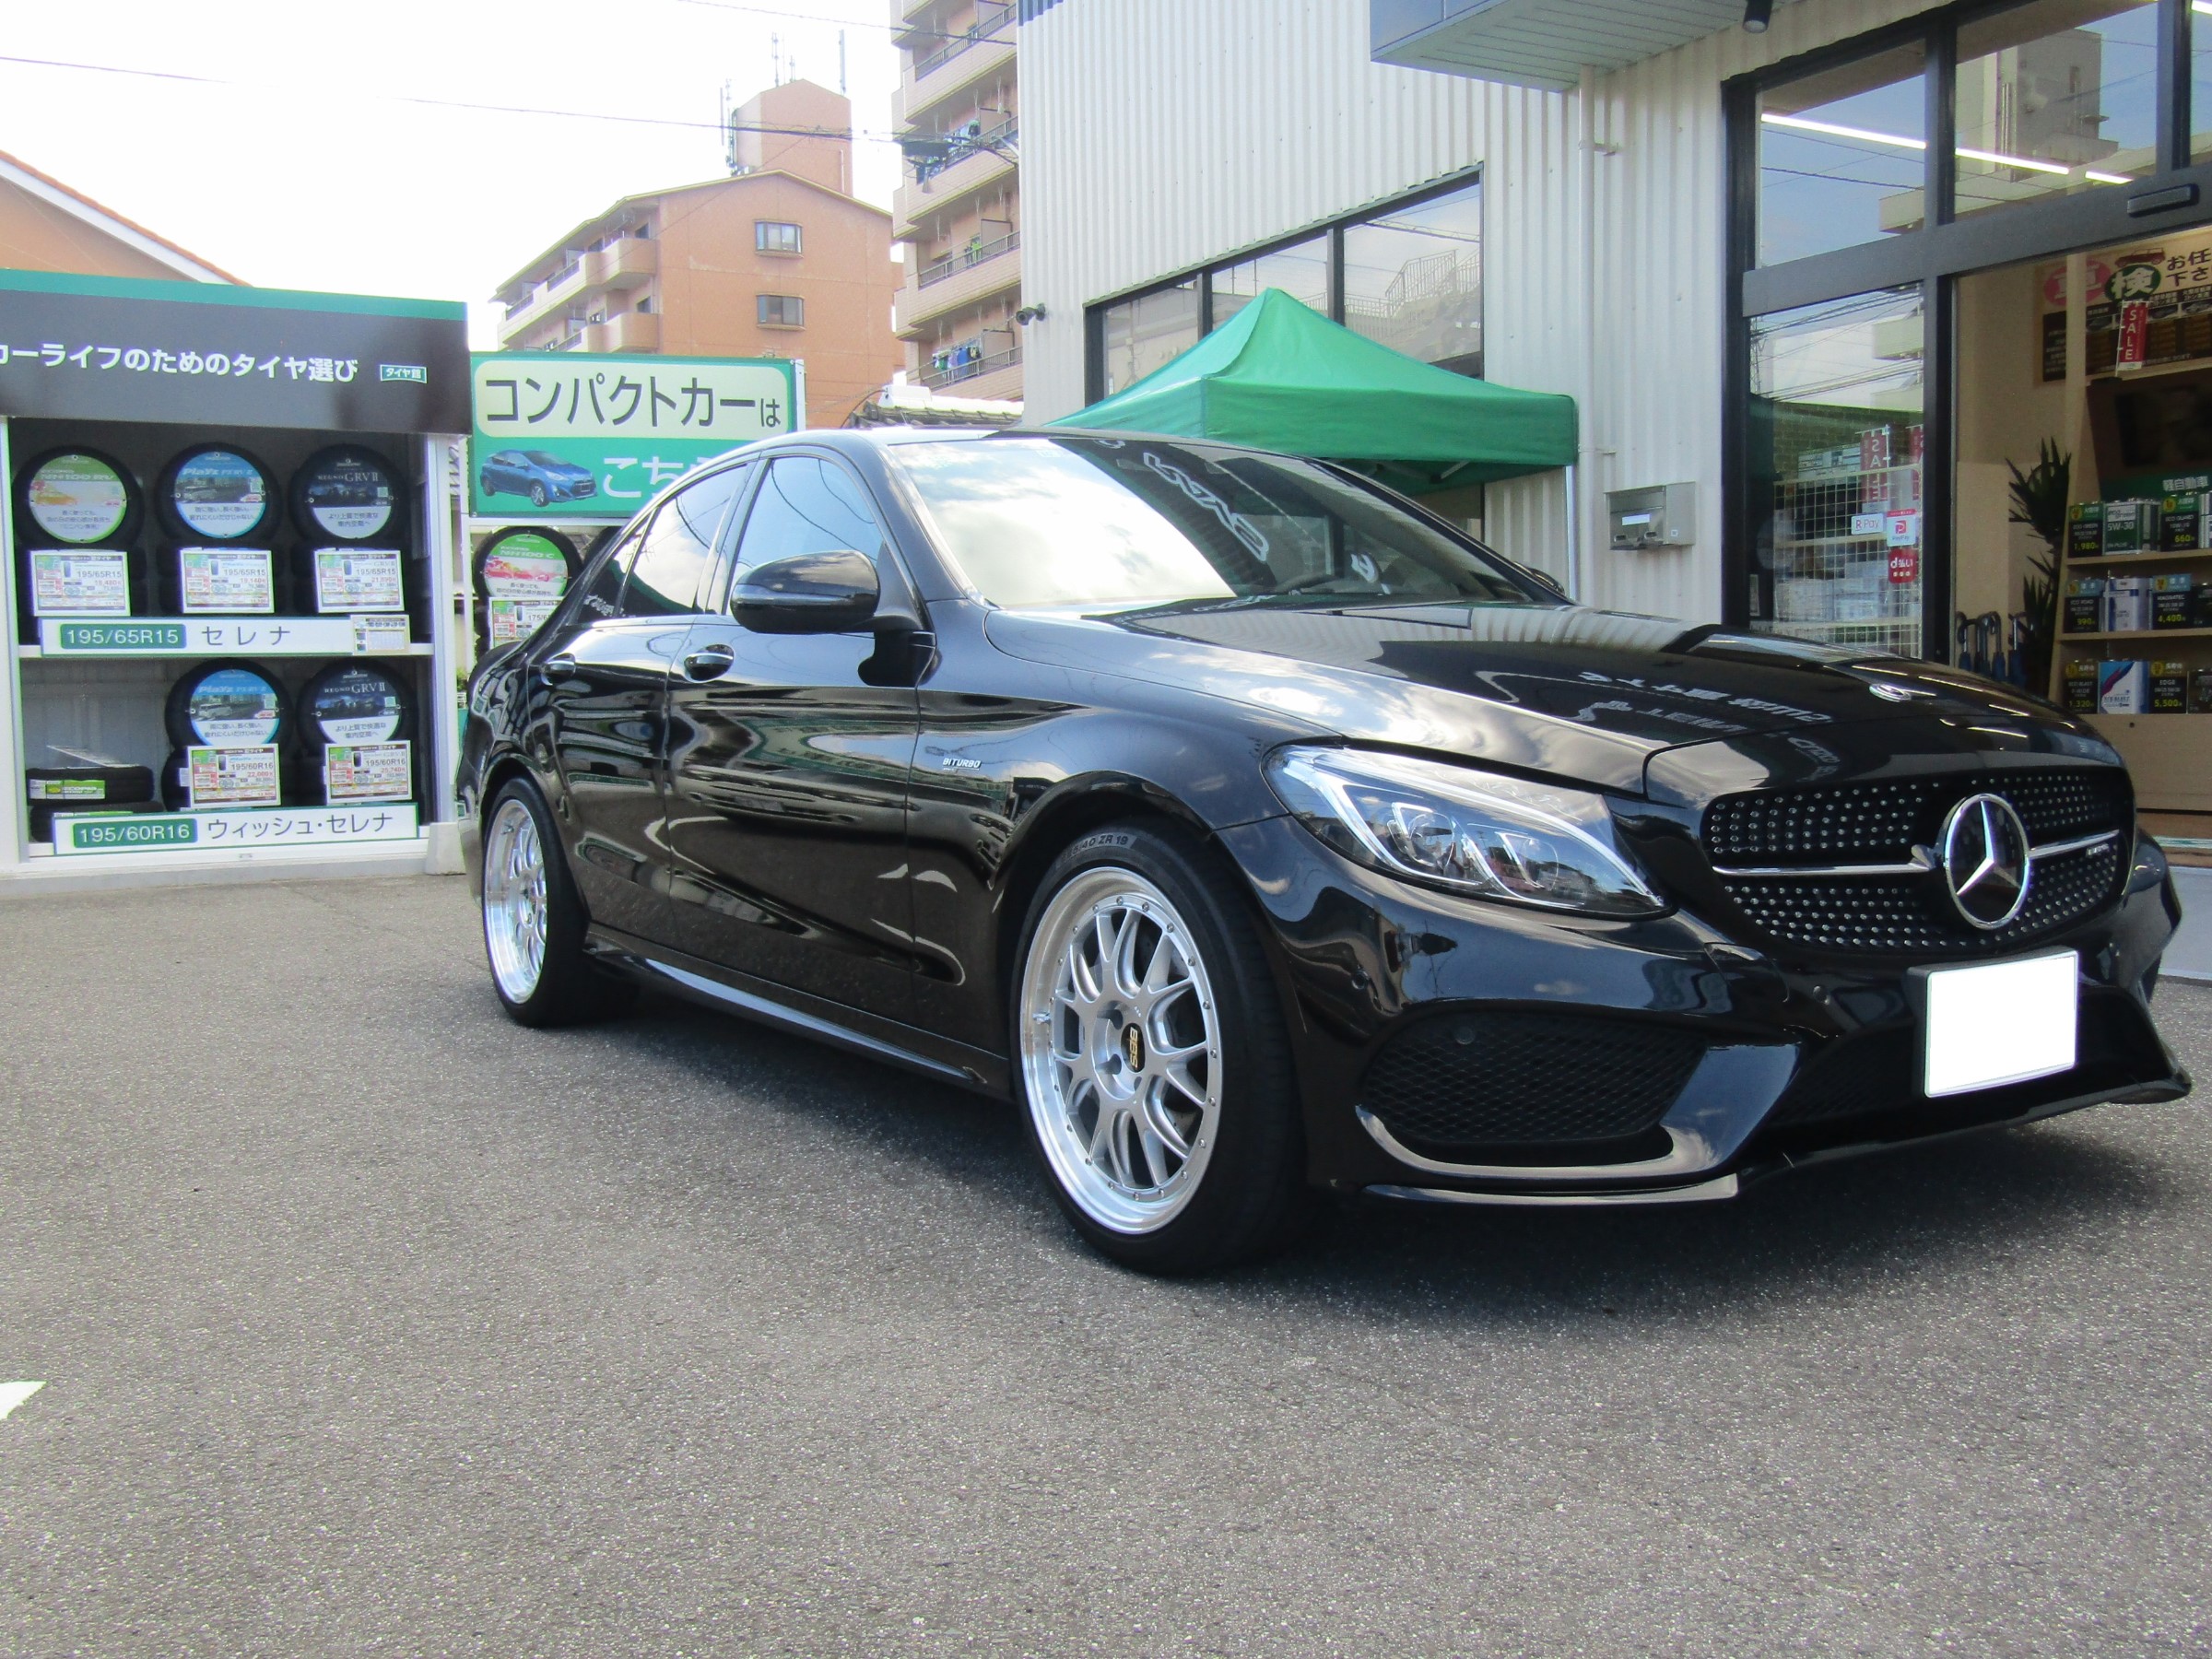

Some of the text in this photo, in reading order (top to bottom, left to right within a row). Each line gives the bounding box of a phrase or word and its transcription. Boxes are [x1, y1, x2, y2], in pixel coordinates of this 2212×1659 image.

[2124, 310, 2136, 360] SALE
[385, 368, 422, 379] タイヤ館
[485, 372, 782, 429] コンパクトカーは
[603, 456, 715, 499] こち
[1864, 518, 1880, 528] Pay
[2107, 521, 2134, 532] 5W-30
[77, 571, 122, 579] 195/65R15
[66, 629, 179, 644] 195/65R15
[201, 626, 290, 646] セレナ
[231, 762, 274, 771] 195/60R16
[366, 758, 406, 767] 195/60R16
[942, 757, 982, 769] BITURBO
[208, 812, 394, 840] ウィッシュ・セレナ
[79, 823, 191, 843] 195/60R16
[1098, 834, 1114, 845] ZR
[1116, 835, 1129, 845] 19
[1129, 1026, 1139, 1068] BBS
